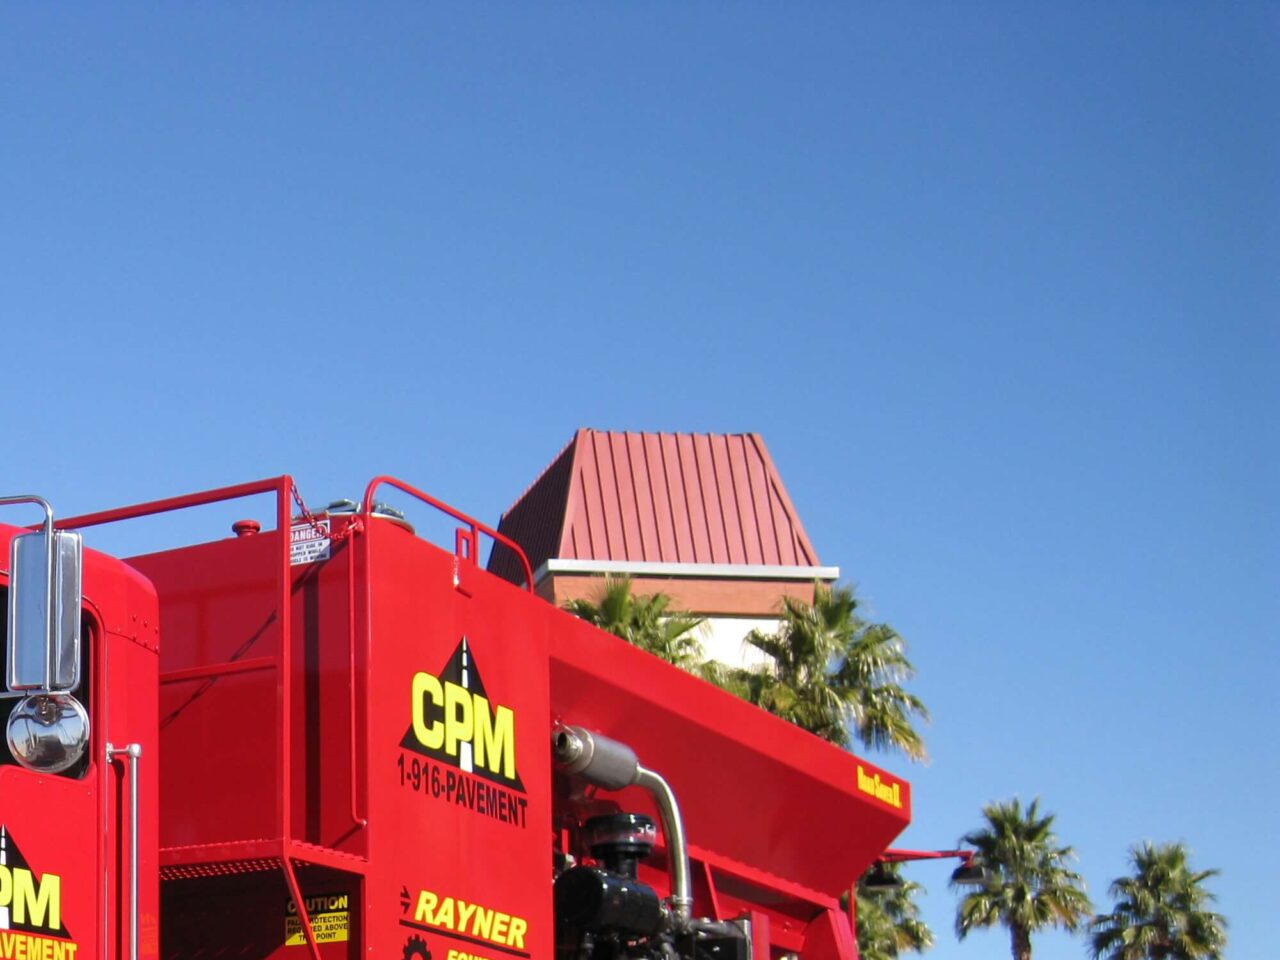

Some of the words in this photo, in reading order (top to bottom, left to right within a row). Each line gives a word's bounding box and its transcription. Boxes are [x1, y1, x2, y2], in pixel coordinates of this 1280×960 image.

[411, 671, 516, 780] CPM
[397, 753, 528, 829] 1-916-PAVEMENT
[287, 895, 349, 913] CUTION
[414, 889, 528, 949] RAYNER
[316, 931, 337, 941] POINT
